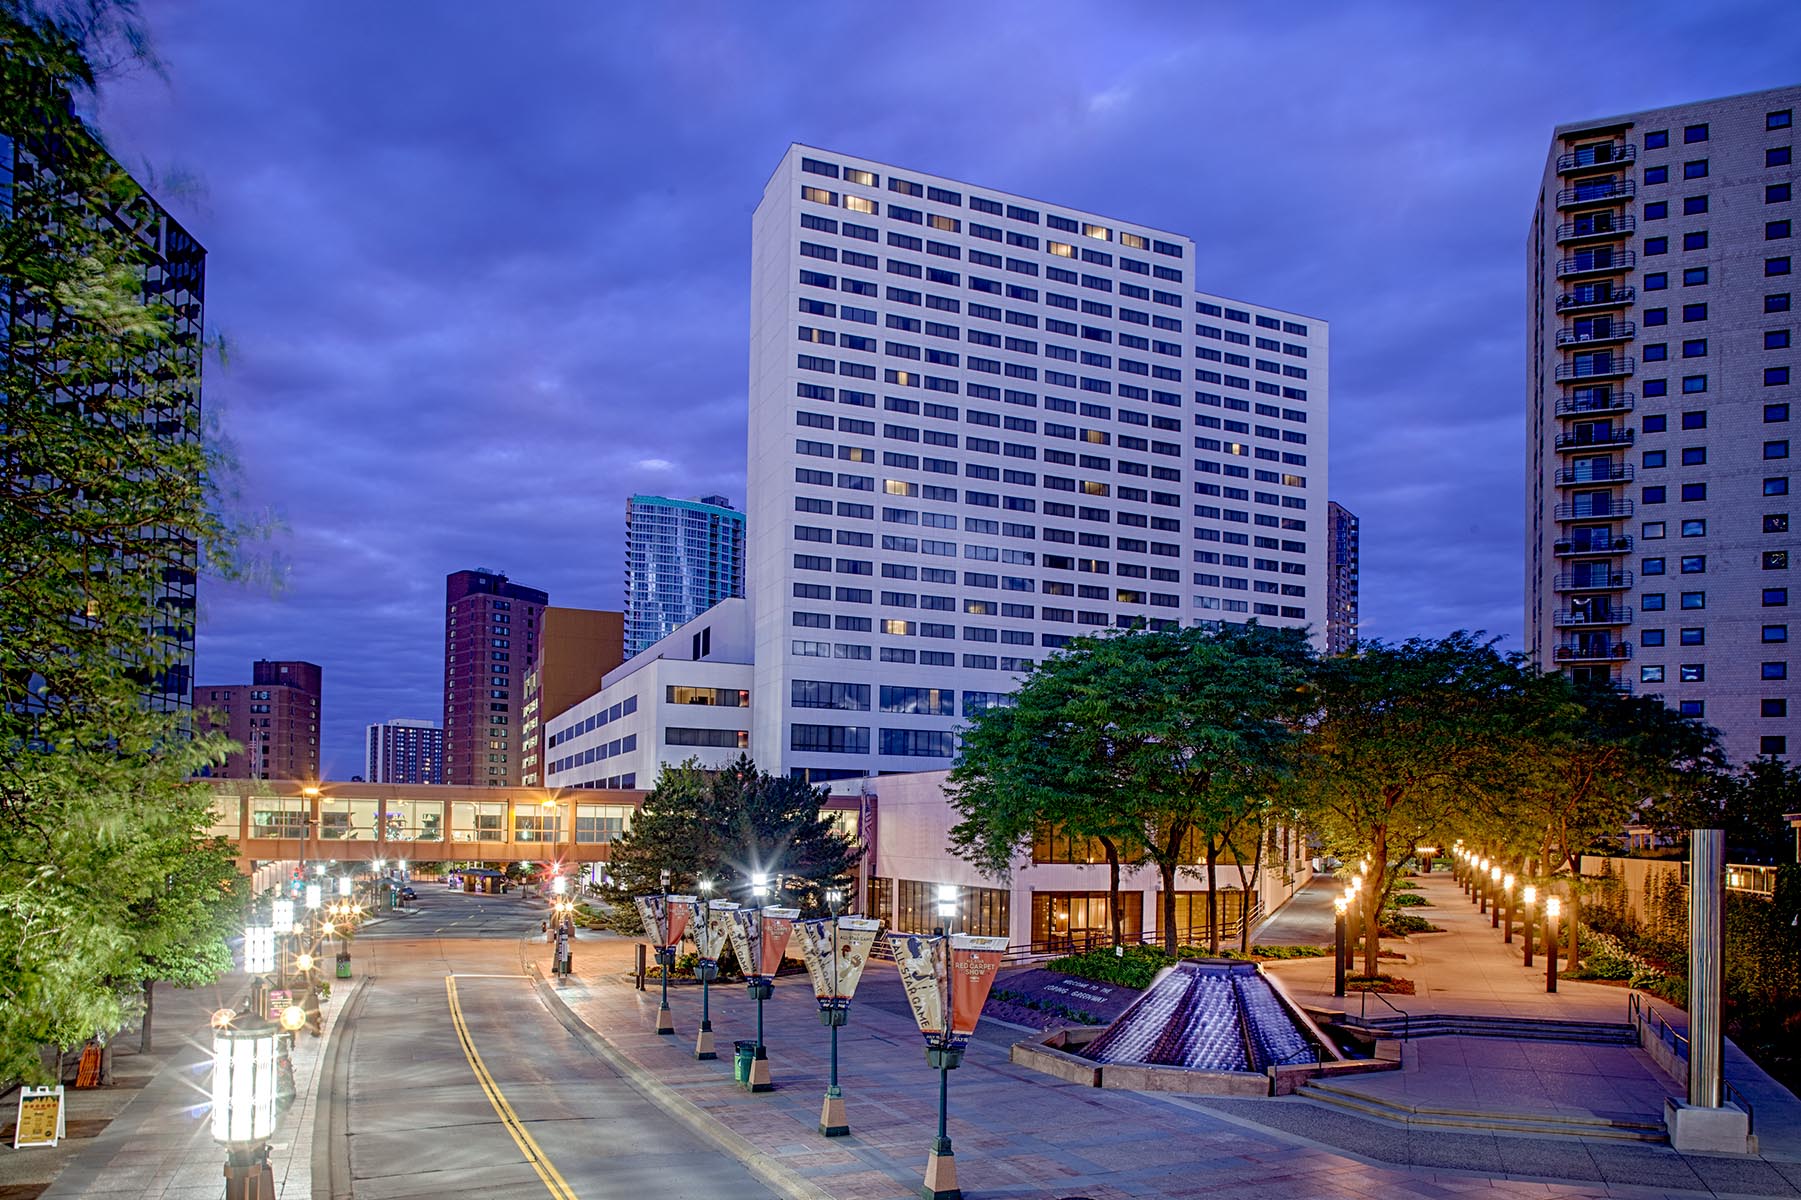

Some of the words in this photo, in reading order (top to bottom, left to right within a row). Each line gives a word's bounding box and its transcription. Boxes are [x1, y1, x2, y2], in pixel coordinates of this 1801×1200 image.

[730, 931, 741, 951] STAR
[737, 950, 749, 973] GAME
[969, 962, 996, 970] CARPET
[892, 944, 906, 965] ALL
[900, 966, 919, 996] STAR
[911, 996, 931, 1029] GAME
[1043, 984, 1070, 995] LORING
[1070, 990, 1108, 1003] GREENWAY
[1063, 979, 1090, 989] WELCOME
